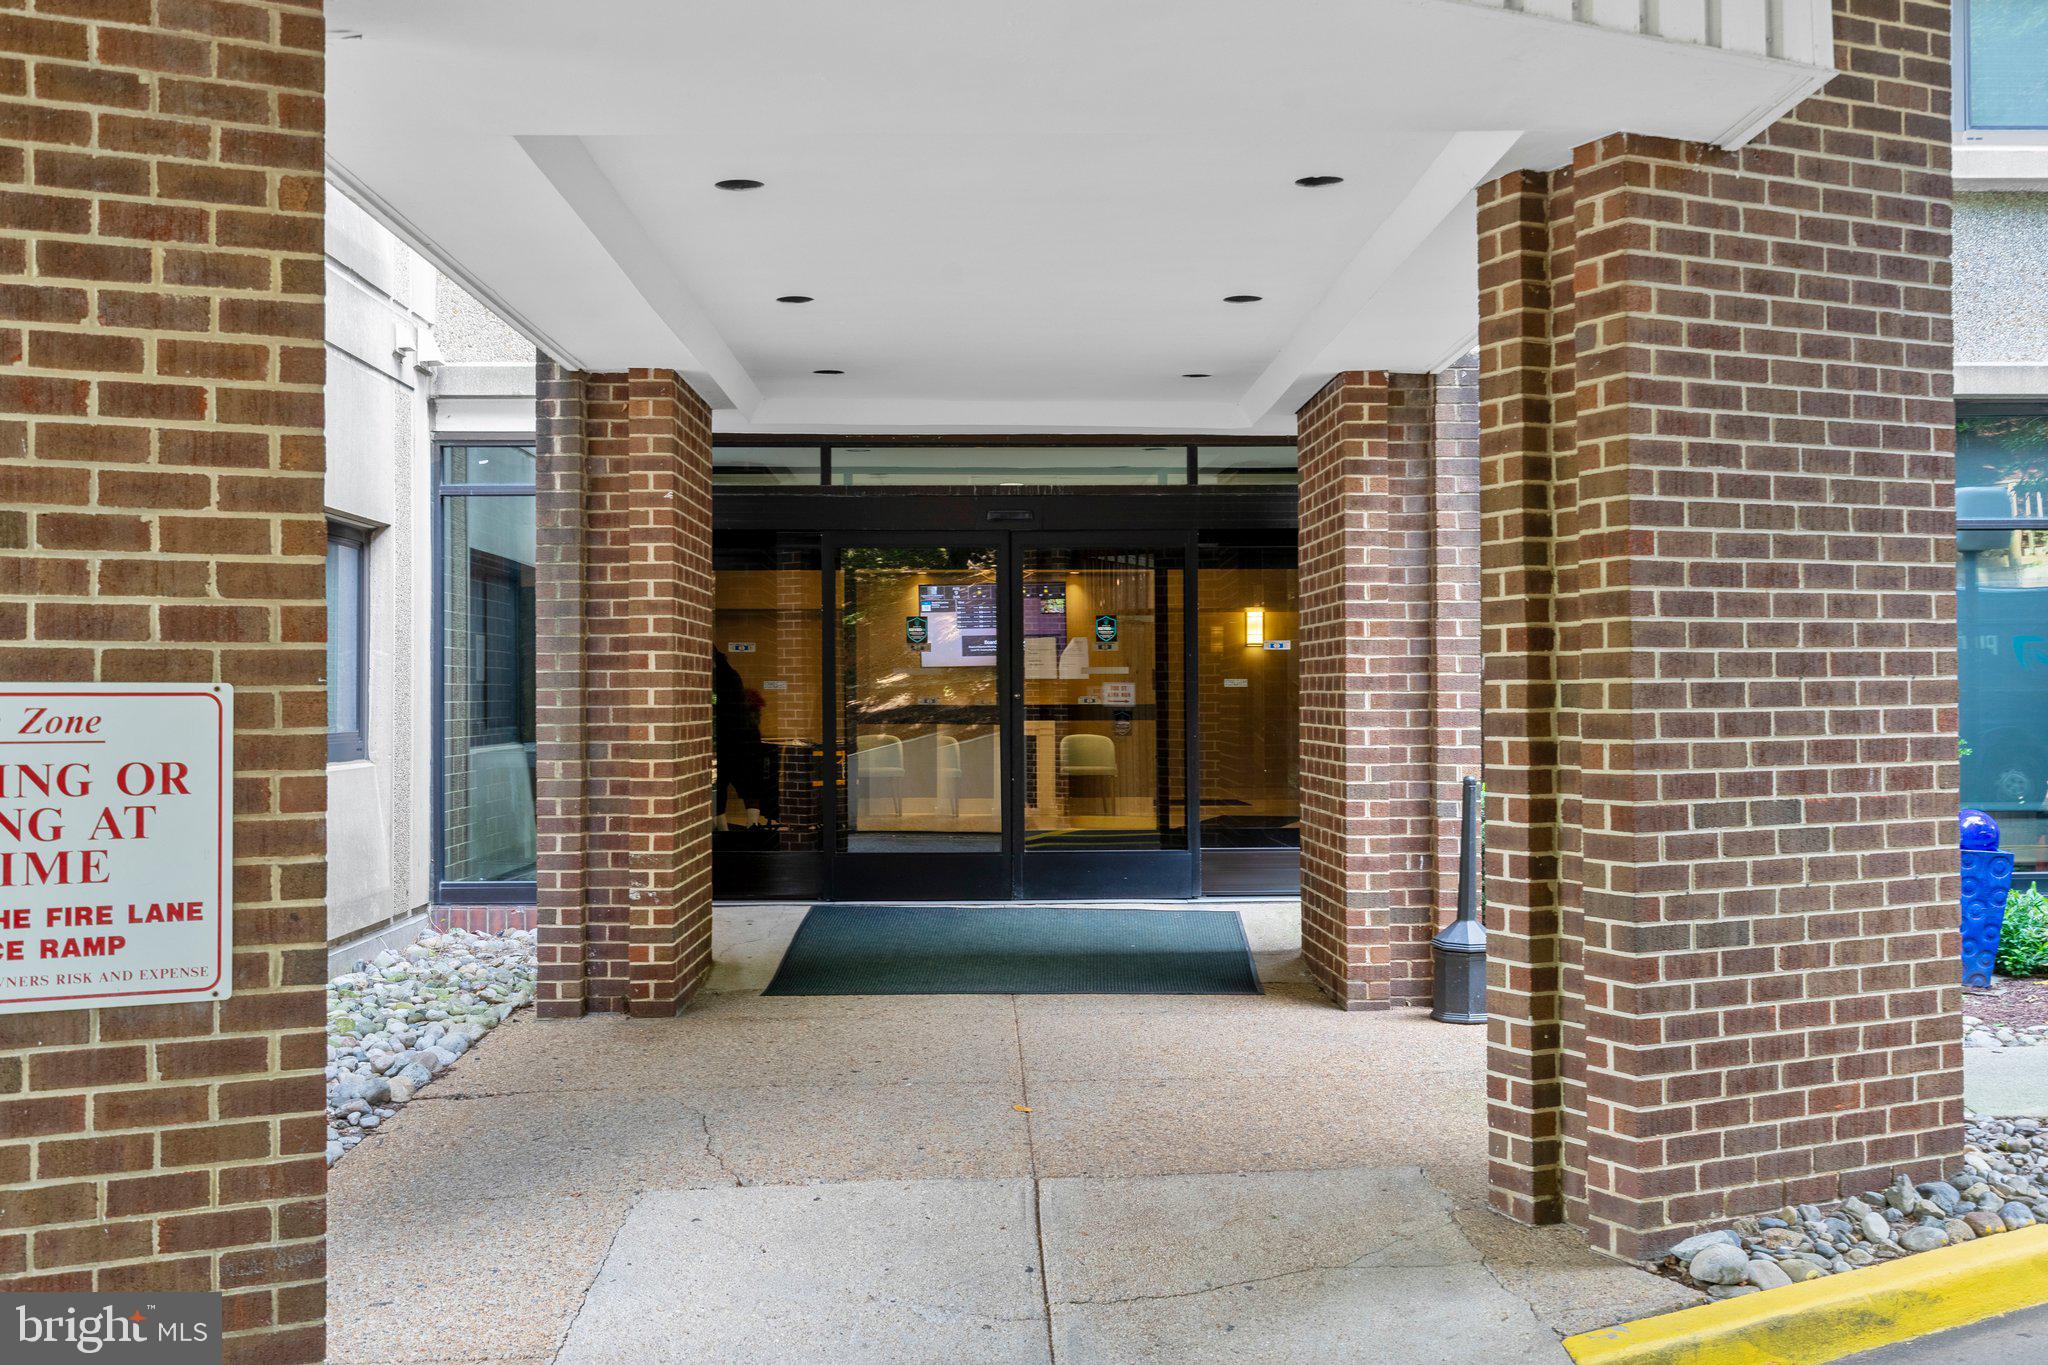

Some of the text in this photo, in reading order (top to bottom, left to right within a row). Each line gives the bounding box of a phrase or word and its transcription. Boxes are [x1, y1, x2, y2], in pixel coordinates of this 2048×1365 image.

[18, 706, 102, 735] Zone
[116, 761, 192, 797] OR
[89, 804, 158, 841] AT
[46, 904, 114, 928] FIRE
[128, 902, 204, 925] LANE
[0, 935, 127, 961] E RAMP
[56, 972, 94, 986] RISK
[99, 970, 134, 983] AND
[140, 965, 210, 981] EXPENSE
